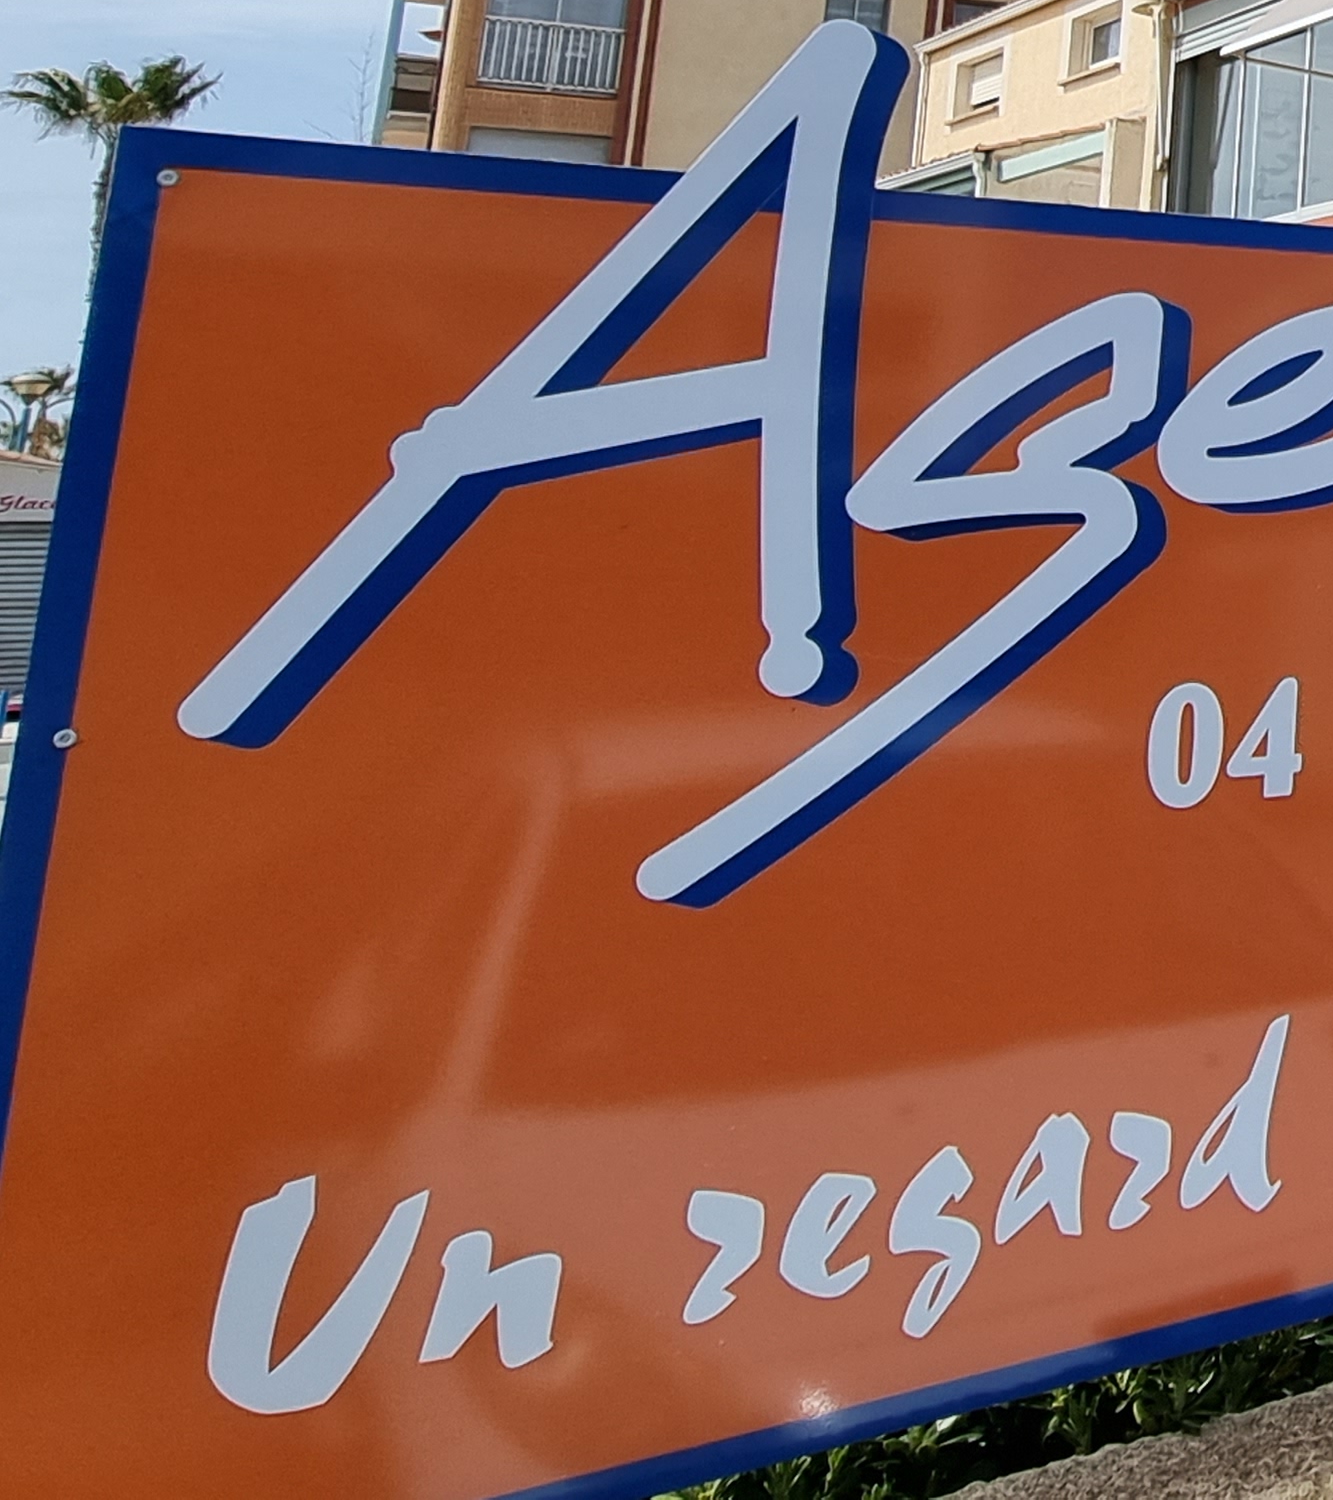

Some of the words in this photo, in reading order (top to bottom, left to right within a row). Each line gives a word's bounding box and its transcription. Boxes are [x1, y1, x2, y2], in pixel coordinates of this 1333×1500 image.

[1147, 676, 1303, 808] 04
[207, 1174, 563, 1414] Un
[682, 1012, 1290, 1340] regard
